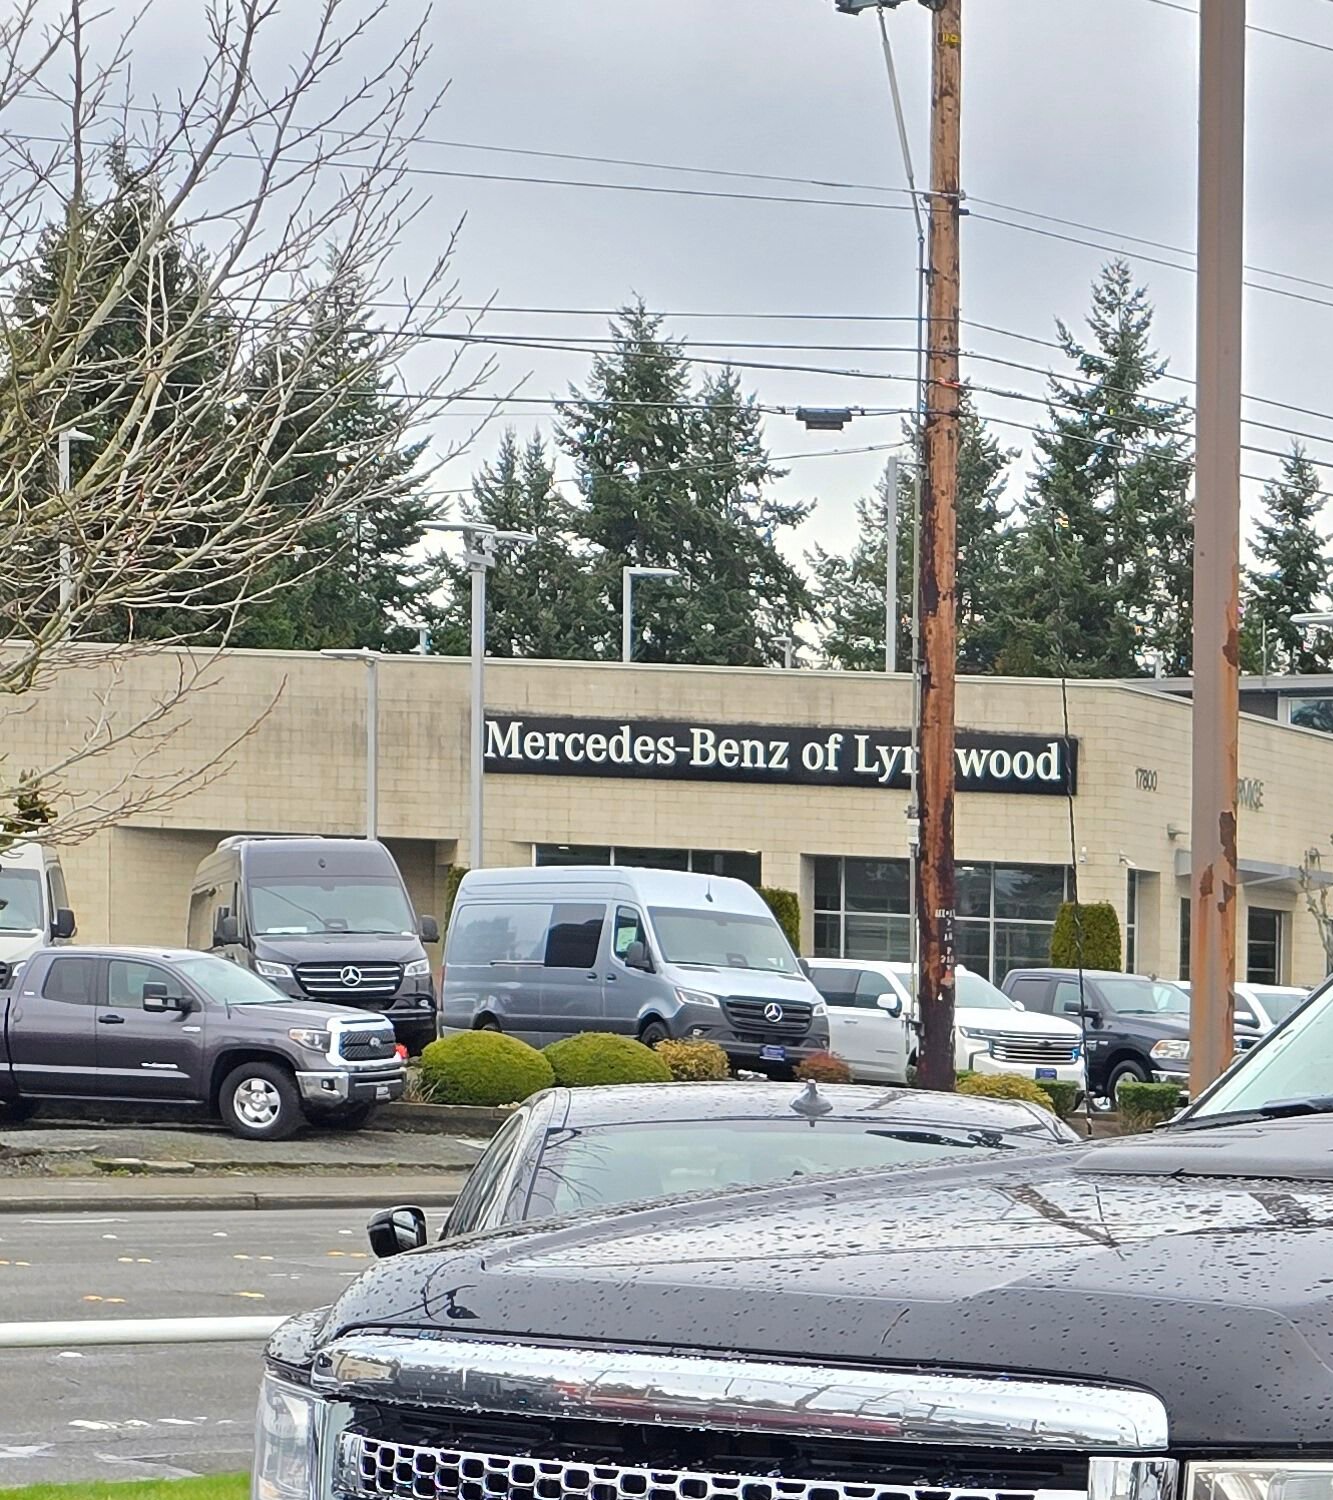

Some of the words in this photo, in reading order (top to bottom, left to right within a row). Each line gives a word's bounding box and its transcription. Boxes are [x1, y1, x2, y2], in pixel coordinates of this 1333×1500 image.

[484, 720, 790, 770] Mercedes-Benz
[801, 733, 844, 772] of
[853, 733, 1061, 783] Lywood
[1135, 767, 1158, 792] 17800
